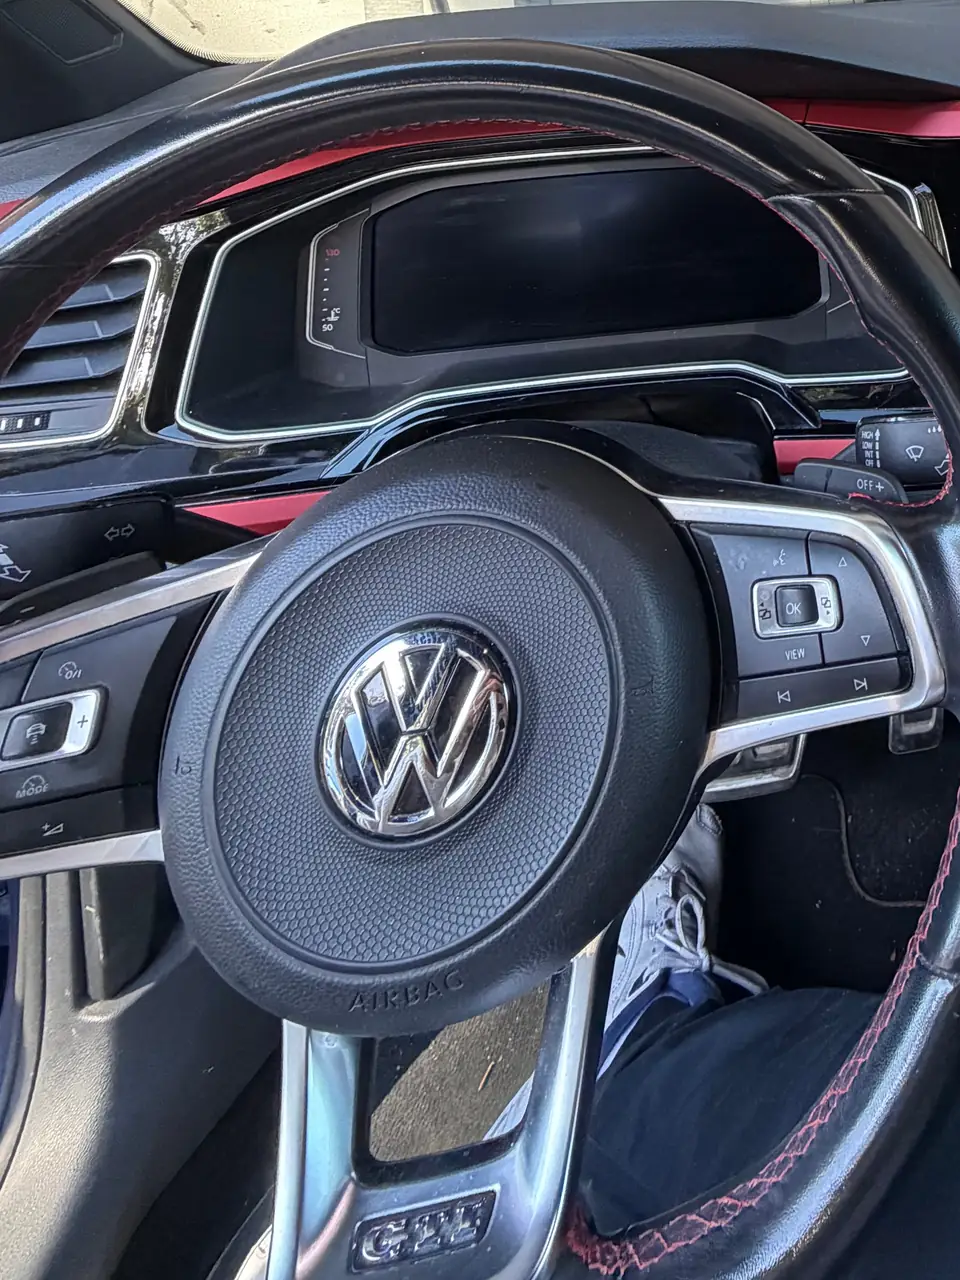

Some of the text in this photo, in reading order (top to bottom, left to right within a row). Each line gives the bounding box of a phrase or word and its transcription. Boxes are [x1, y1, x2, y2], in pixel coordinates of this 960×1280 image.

[862, 431, 874, 439] HIGH
[862, 441, 873, 450] LOW
[856, 478, 873, 490] OFF
[785, 602, 802, 614] OK
[784, 648, 806, 660] VIEW
[15, 782, 48, 799] MODE
[349, 971, 464, 1013] AIRBAG
